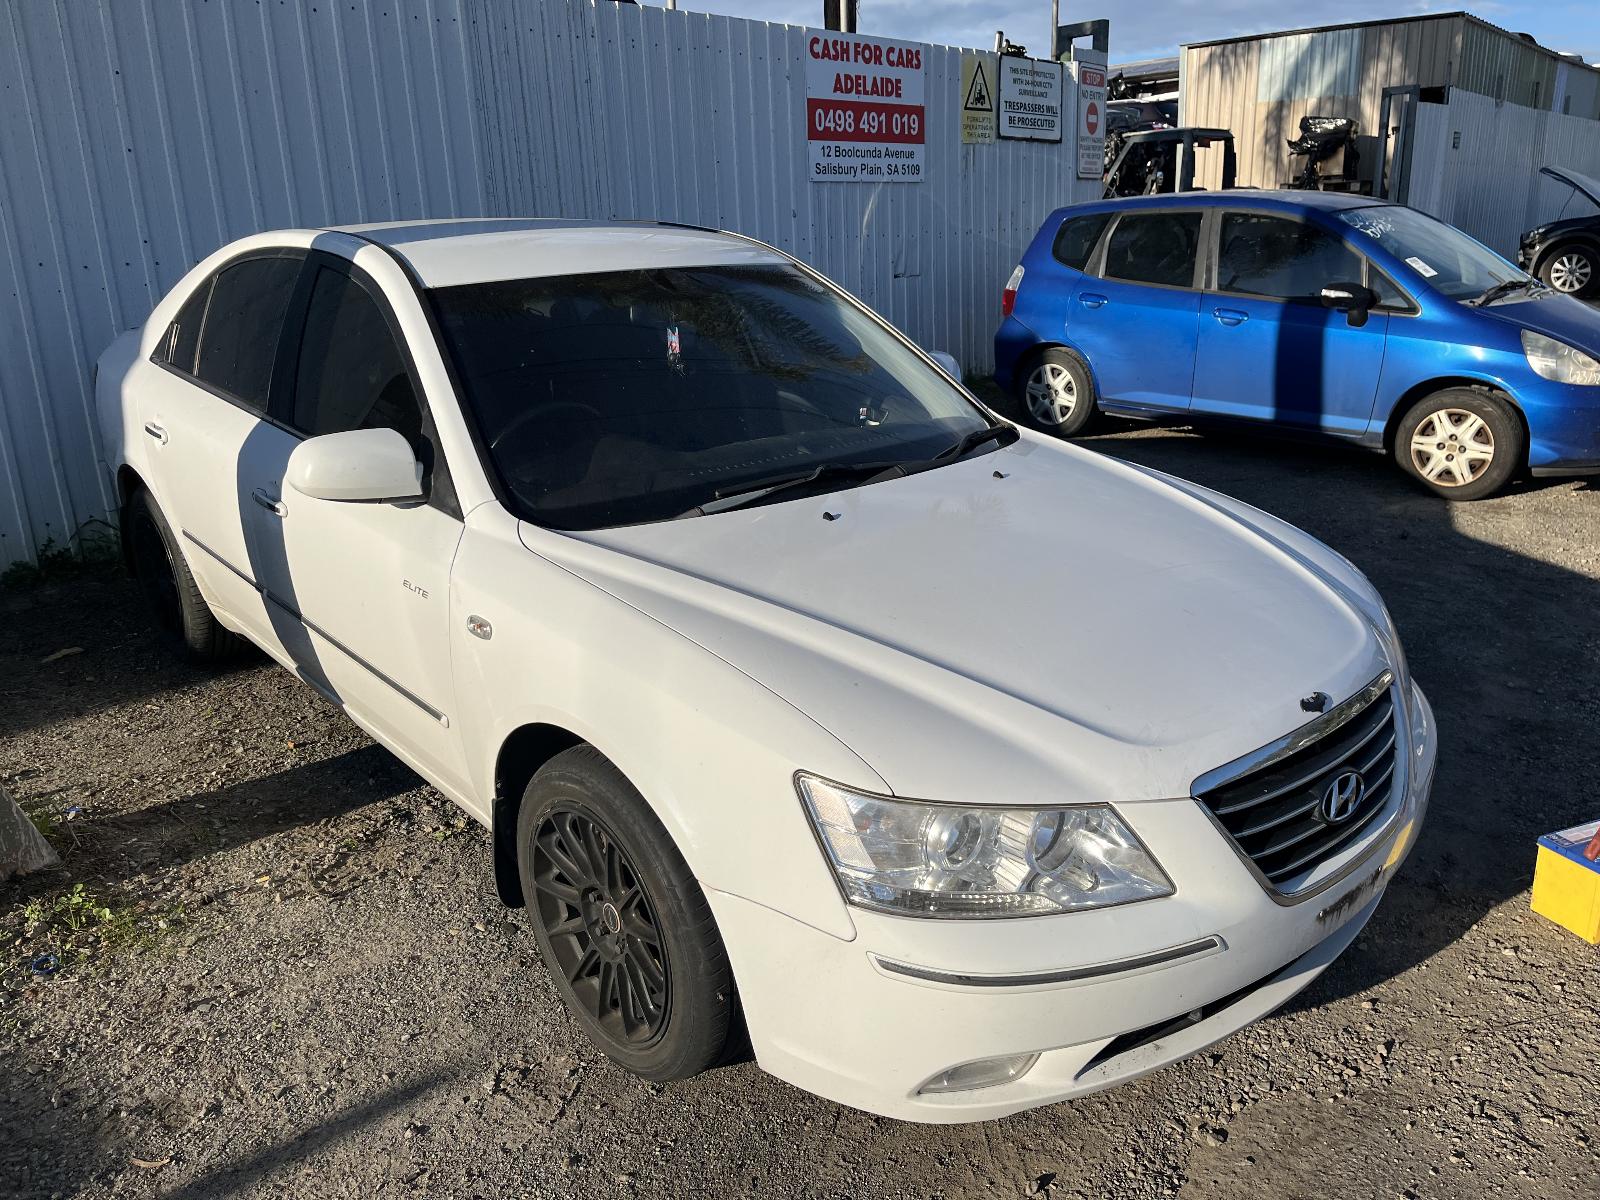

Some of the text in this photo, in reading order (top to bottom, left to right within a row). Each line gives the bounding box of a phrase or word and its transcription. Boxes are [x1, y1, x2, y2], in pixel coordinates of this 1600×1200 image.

[809, 37, 921, 70] CASH FOR CARS
[832, 73, 902, 98] ADELAIDE
[1086, 73, 1100, 84] STOP
[1082, 89, 1104, 101] NO ENTRY
[1004, 100, 1058, 115] TRESPASSERS WILL
[815, 108, 919, 136] 0498 491 019
[1008, 115, 1056, 129] BE PROSECUTED
[820, 145, 915, 159] 12 Boolcunda Avenue
[815, 162, 920, 177] Salisbury Plain, SA 5109
[402, 579, 429, 600] ELITE
